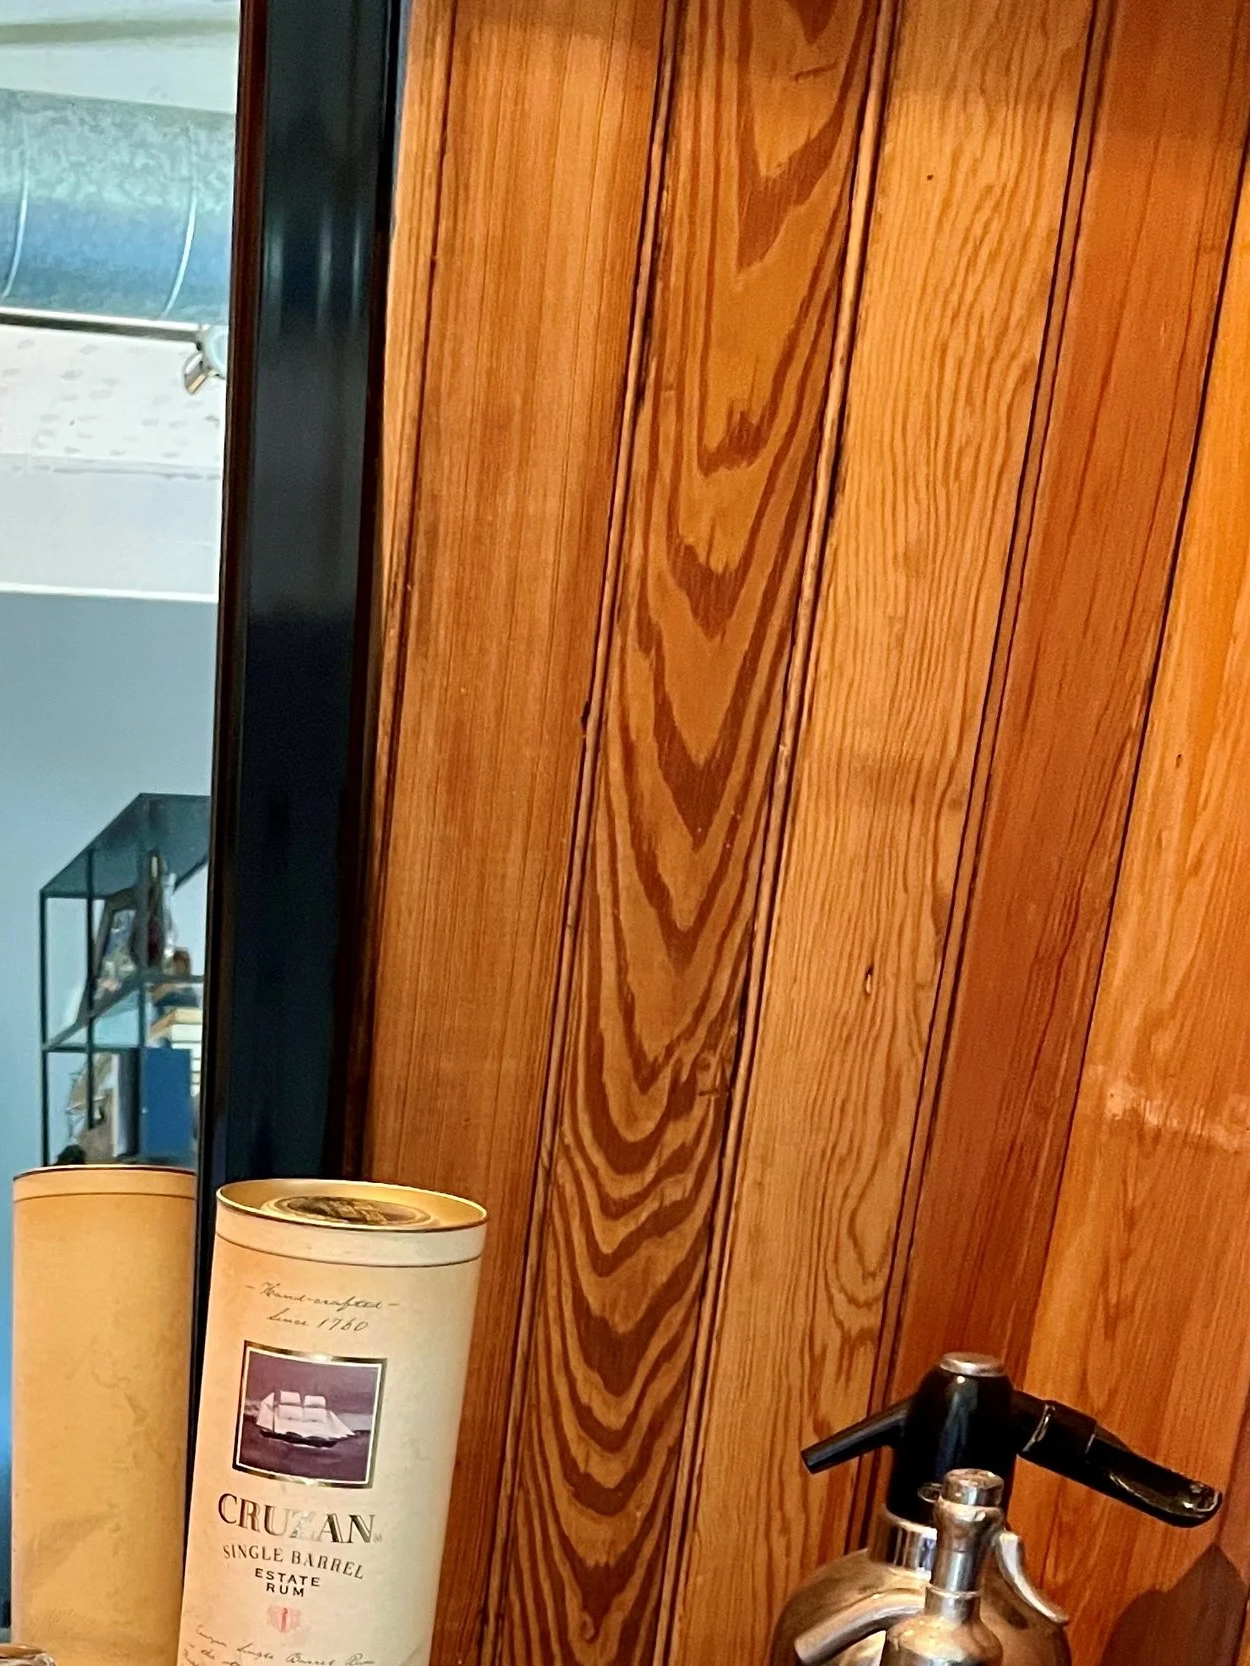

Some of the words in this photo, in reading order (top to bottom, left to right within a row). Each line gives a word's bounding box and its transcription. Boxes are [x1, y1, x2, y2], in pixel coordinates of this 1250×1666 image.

[318, 1317, 369, 1332] 1760
[218, 1492, 377, 1545] CRUZAN
[223, 1544, 284, 1563] SINGLE
[291, 1550, 364, 1580] BARREL
[255, 1567, 321, 1587] ESTATE
[266, 1582, 305, 1598] RUM
